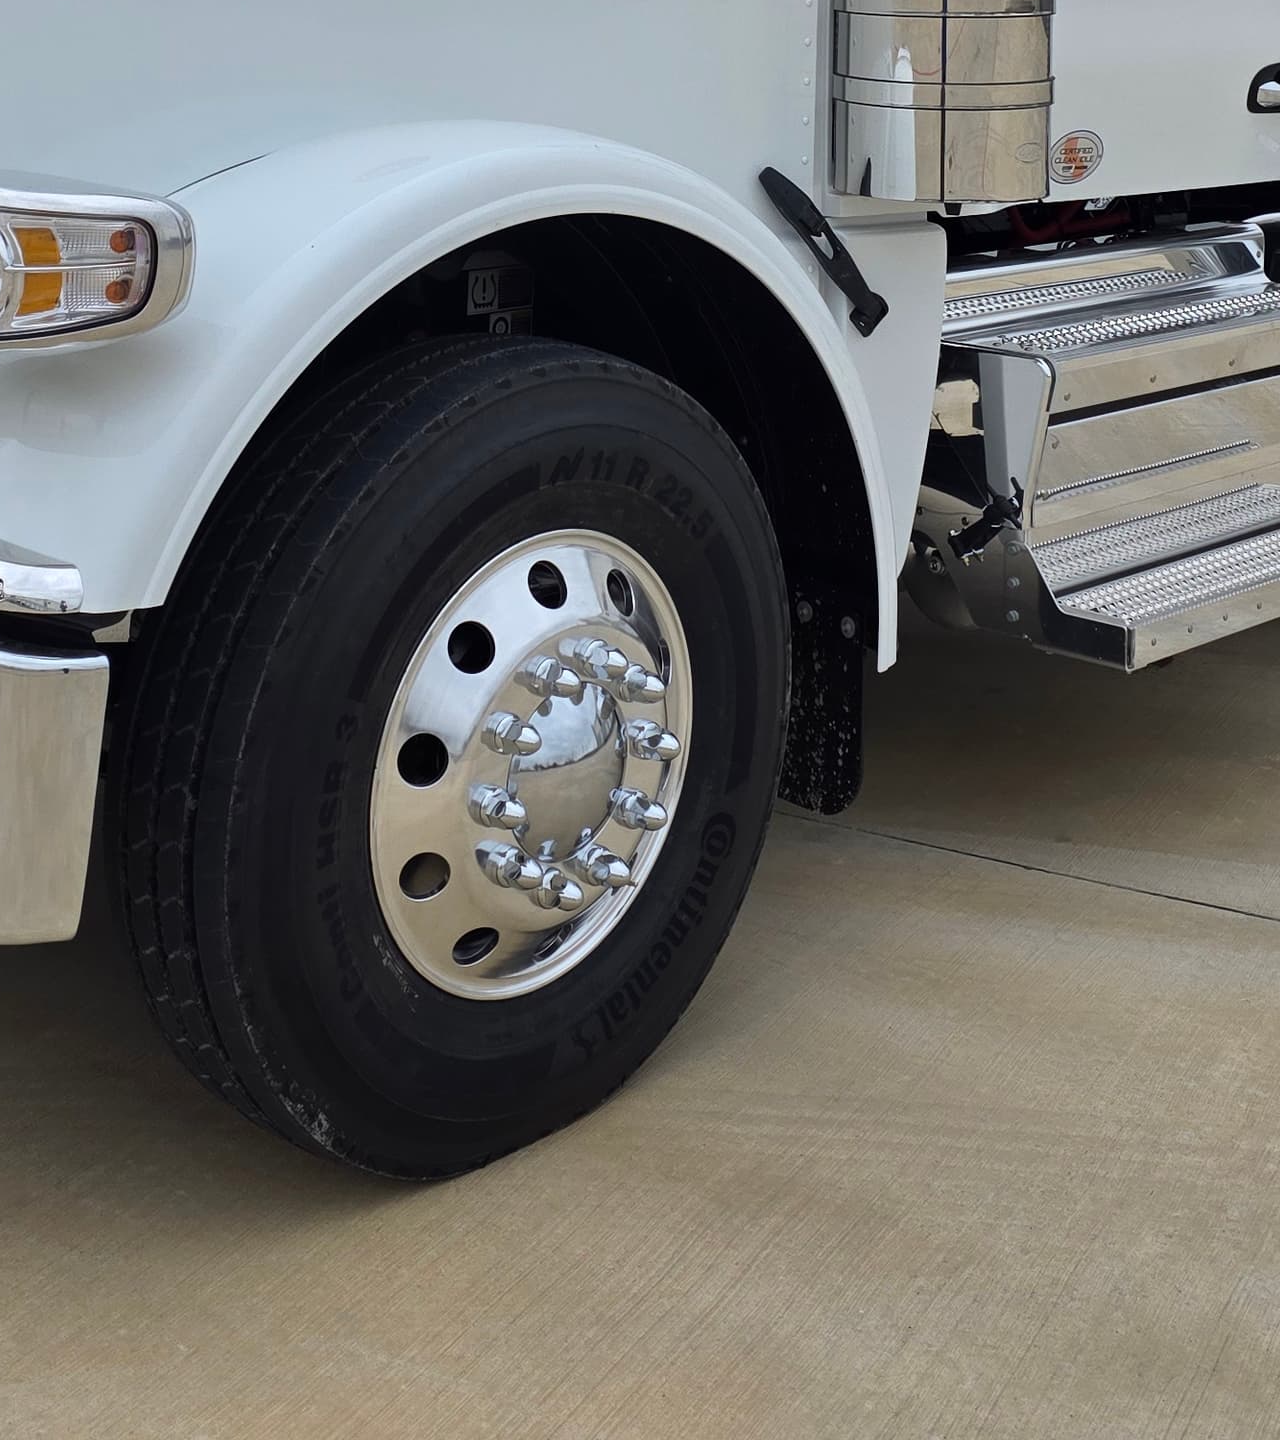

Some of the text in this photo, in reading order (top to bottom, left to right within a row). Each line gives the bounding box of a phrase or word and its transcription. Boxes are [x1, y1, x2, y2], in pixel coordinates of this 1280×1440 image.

[1054, 155, 1077, 164] CLEAN
[1059, 147, 1094, 156] CERTIFIED
[590, 450, 713, 539] 11 R 22.5
[594, 811, 737, 1042] Continental
